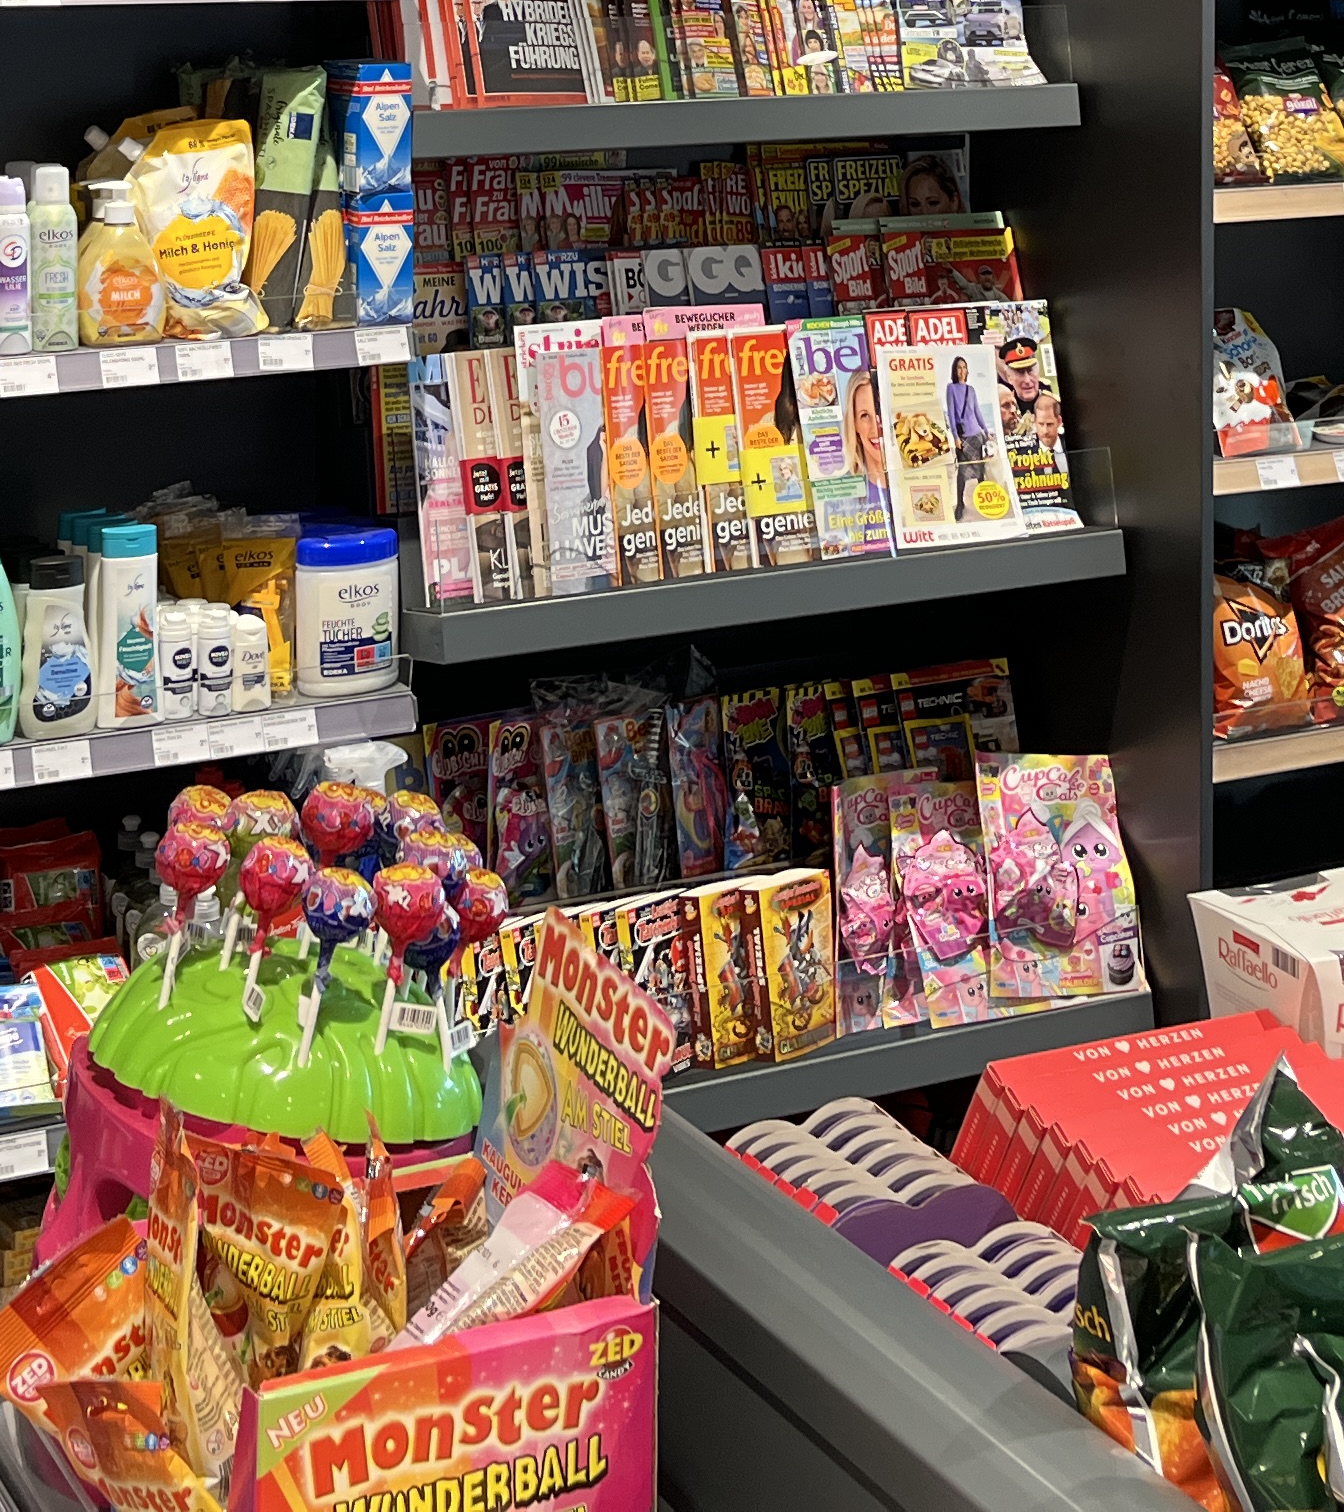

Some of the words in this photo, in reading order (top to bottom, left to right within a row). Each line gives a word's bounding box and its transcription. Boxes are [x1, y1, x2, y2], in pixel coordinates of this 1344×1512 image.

[509, 43, 580, 69] FÜHRUNG
[375, 101, 399, 112] Alpen
[1286, 97, 1317, 111] göral
[379, 112, 397, 122] Salz
[838, 159, 898, 179] FREIZEIT
[839, 179, 899, 200] SPEZIAL
[39, 229, 74, 241] elkos
[374, 232, 400, 243] Alpen
[159, 241, 188, 259] Milch
[203, 240, 235, 253] Honig
[377, 243, 397, 253] Salz
[833, 244, 868, 284] Sport
[889, 242, 923, 282] Sport
[422, 276, 456, 288] MEINE
[848, 280, 872, 297] Bild
[905, 276, 926, 293] Bild
[111, 291, 141, 301] MILCH
[675, 312, 735, 323] BEWEGLICHER
[917, 313, 962, 338] ADEL
[889, 358, 934, 371] GRATIS
[1009, 454, 1054, 469] Projekt
[977, 491, 1005, 504] 50%
[235, 549, 274, 561] elkos
[338, 584, 379, 599] elkos
[322, 619, 355, 628] FEUCHTE
[1222, 618, 1287, 646] Doritos
[323, 626, 362, 641] TÜCHER
[242, 651, 264, 662] Dove
[1243, 678, 1269, 690] NACHO
[1244, 686, 1273, 698] CHEESE
[918, 693, 962, 708] TECHNIC
[1216, 942, 1278, 989] Raffaello
[540, 938, 670, 1071] Monster
[1074, 1045, 1112, 1062] VON
[1136, 1028, 1204, 1050] HERZEN
[556, 1004, 657, 1127] WUNDERBALL
[1093, 1066, 1131, 1083] VON
[1157, 1047, 1226, 1070] HERZEN
[1117, 1084, 1155, 1100] VON
[1182, 1063, 1251, 1088] HERZEN
[1143, 1102, 1181, 1119] VON
[561, 1100, 590, 1131] AM
[593, 1109, 632, 1153] STIEL
[1168, 1119, 1207, 1136] VON
[202, 1192, 323, 1268] Monster
[589, 1333, 642, 1366] ZED
[268, 1394, 325, 1447] NEU
[312, 1381, 599, 1497] Monster
[336, 1437, 607, 1512] WUNDERBALL
